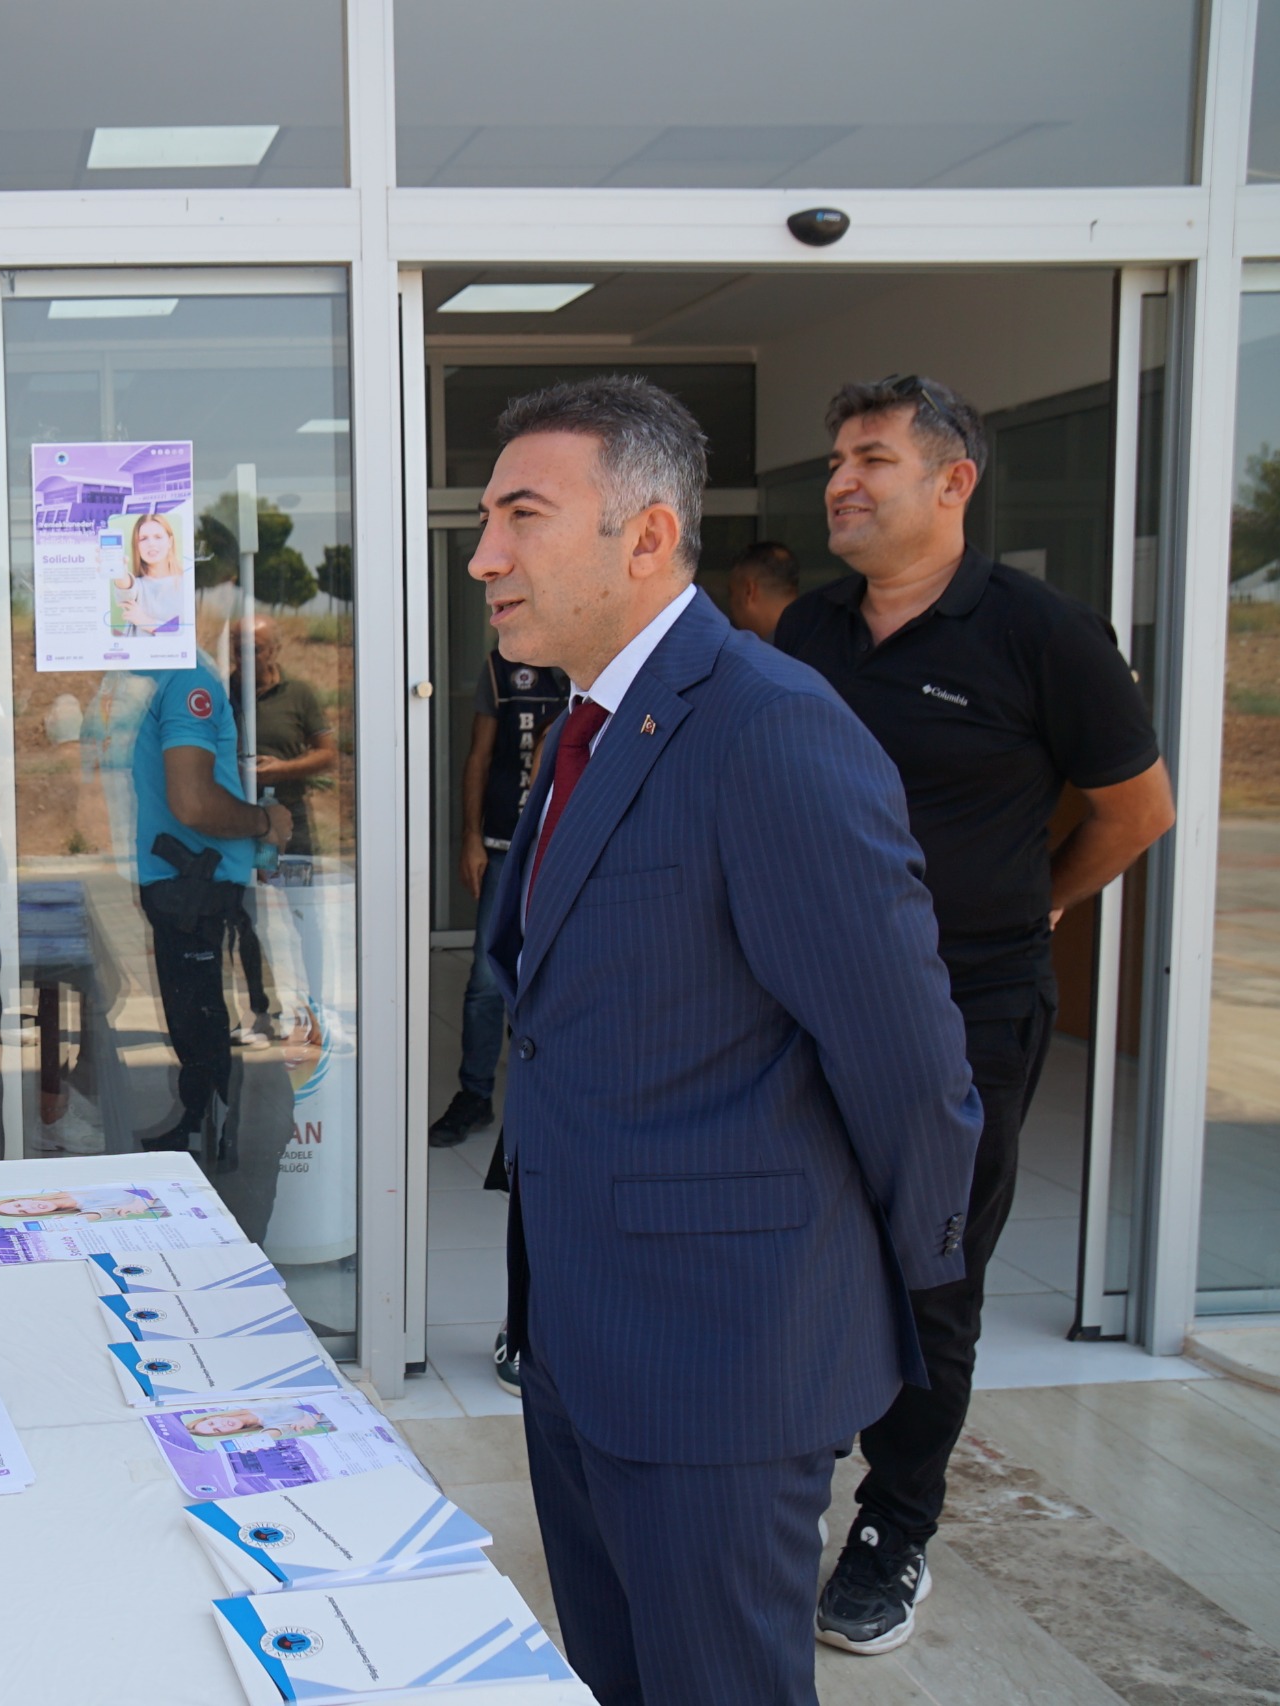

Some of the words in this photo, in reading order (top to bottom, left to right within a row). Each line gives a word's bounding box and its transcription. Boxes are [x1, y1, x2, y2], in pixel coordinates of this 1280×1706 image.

[42, 554, 86, 564] Soliclub
[931, 686, 969, 707] Columbia
[518, 712, 535, 815] BATMA
